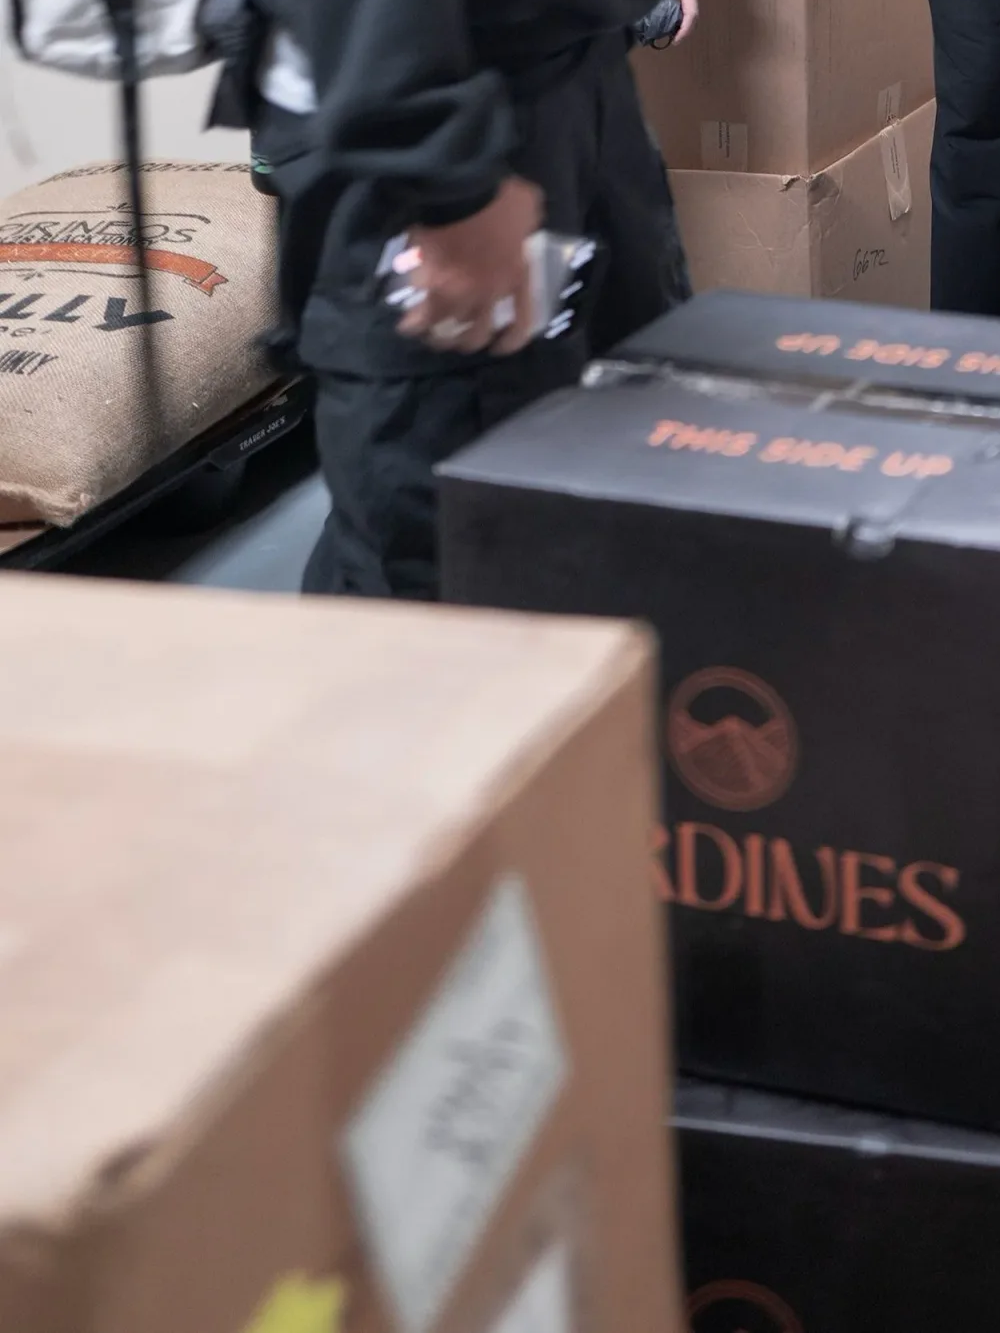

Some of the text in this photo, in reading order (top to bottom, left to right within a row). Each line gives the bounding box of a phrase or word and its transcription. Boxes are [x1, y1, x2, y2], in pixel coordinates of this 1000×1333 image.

[853, 248, 889, 281] 6672
[775, 332, 842, 356] UP
[846, 338, 951, 369] SIDE
[646, 418, 955, 479] THIS SIDE UP
